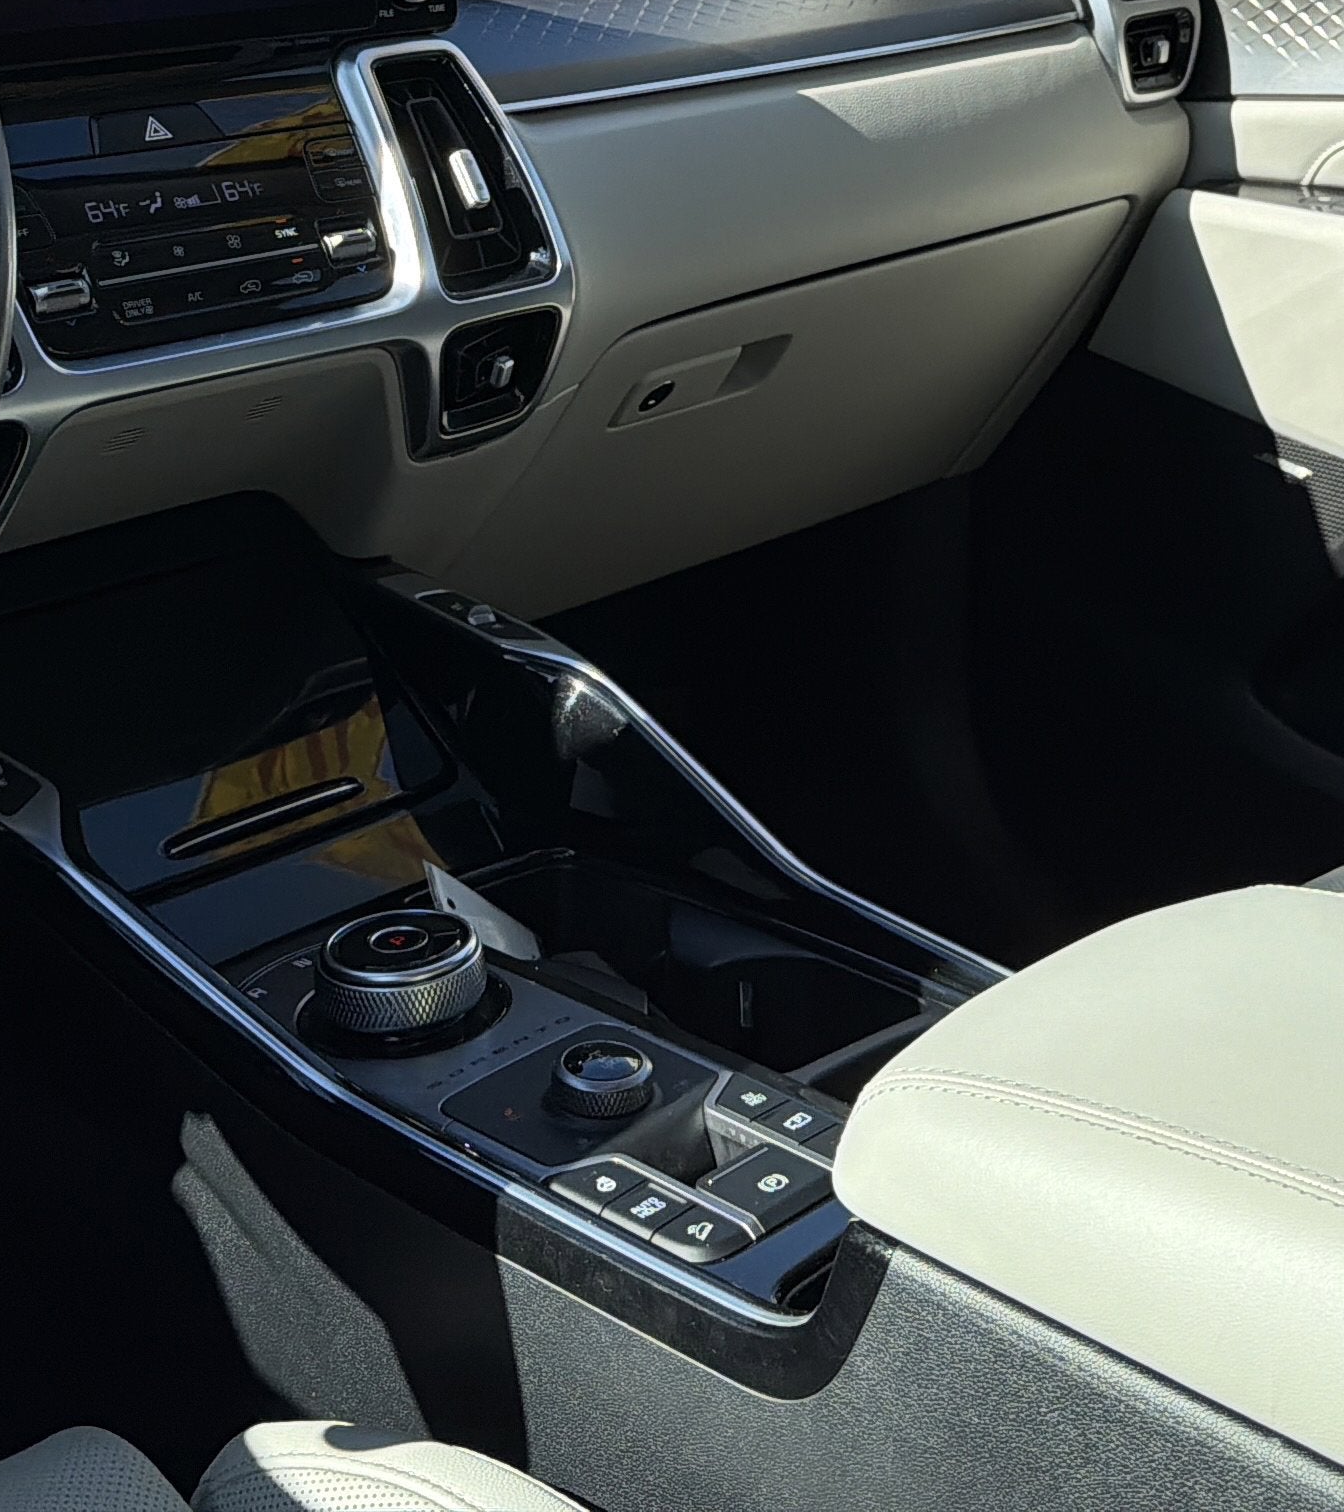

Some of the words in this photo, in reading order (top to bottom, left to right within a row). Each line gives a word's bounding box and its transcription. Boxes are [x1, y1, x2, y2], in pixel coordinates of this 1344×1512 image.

[274, 225, 299, 240] SYNC
[187, 289, 205, 303] A/C
[122, 297, 153, 310] DRIVER
[246, 988, 268, 999] R
